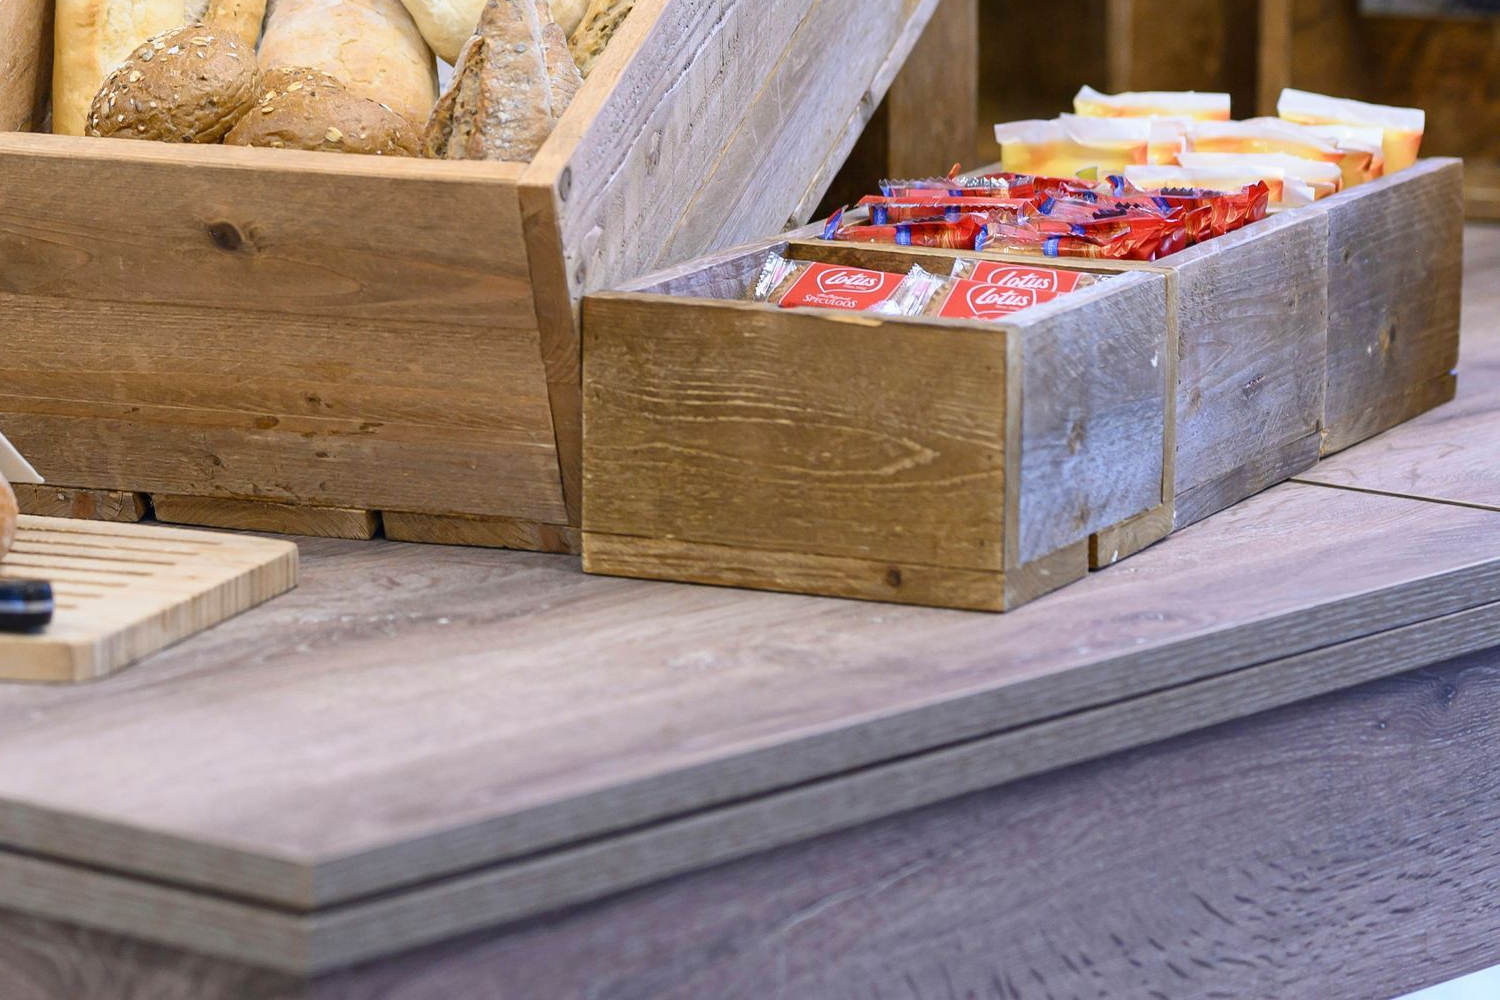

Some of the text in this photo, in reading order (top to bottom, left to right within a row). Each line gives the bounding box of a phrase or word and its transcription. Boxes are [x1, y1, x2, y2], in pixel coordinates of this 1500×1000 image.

[824, 271, 878, 287] Lotus
[997, 270, 1051, 290] Lotus
[803, 293, 858, 309] SPECULOOS
[975, 287, 1030, 307] Lotus
